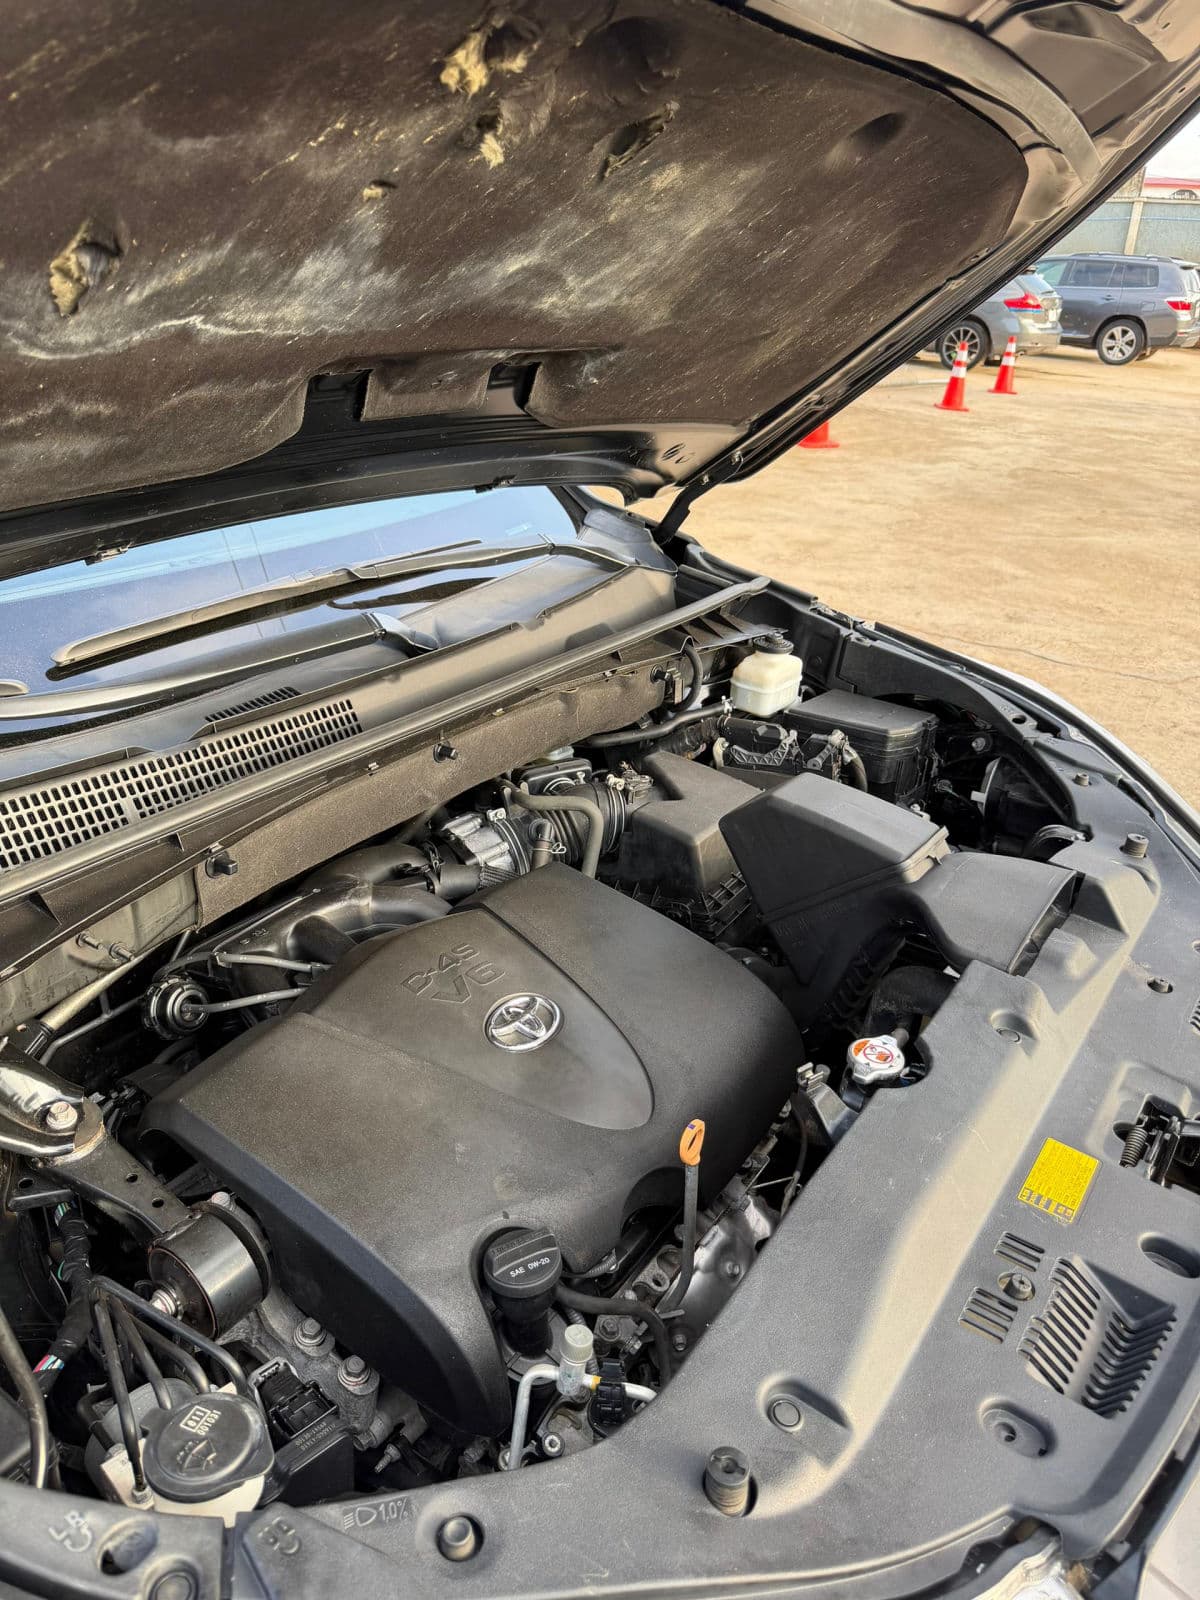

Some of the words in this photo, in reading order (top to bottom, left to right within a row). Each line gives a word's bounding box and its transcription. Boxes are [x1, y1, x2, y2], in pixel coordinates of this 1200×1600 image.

[431, 960, 506, 1004] V6
[509, 1266, 526, 1278] SAE
[527, 1257, 550, 1270] 0W-20
